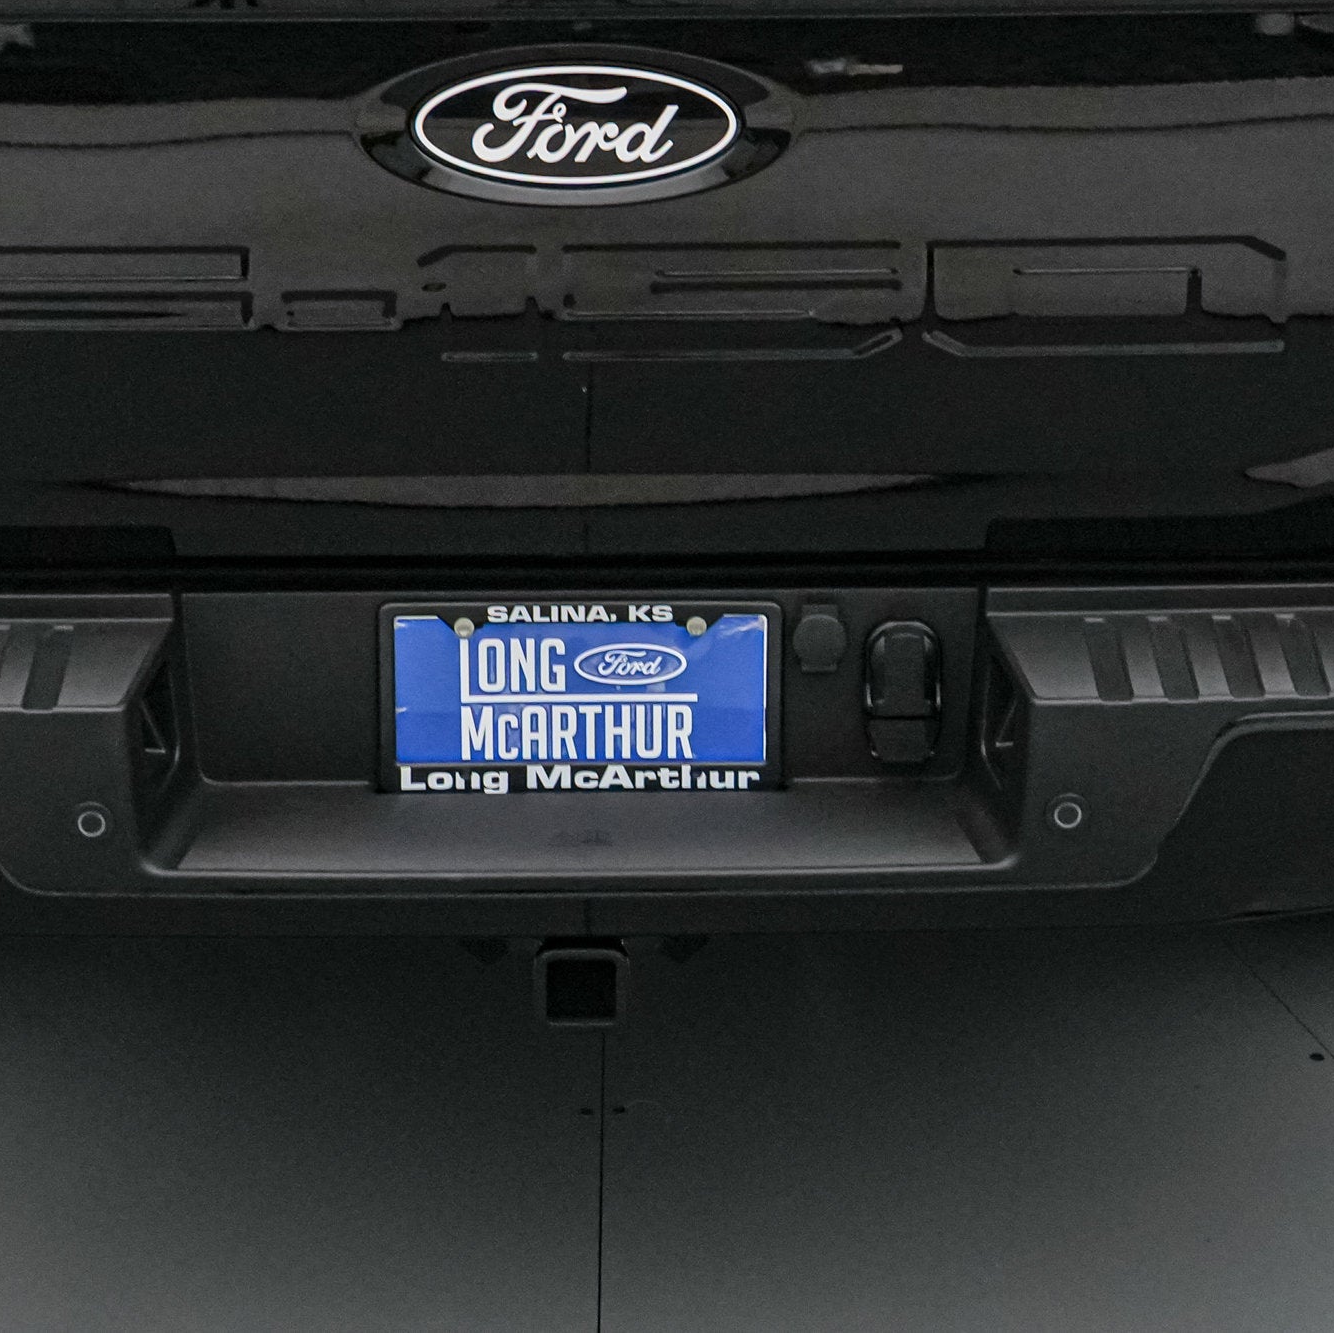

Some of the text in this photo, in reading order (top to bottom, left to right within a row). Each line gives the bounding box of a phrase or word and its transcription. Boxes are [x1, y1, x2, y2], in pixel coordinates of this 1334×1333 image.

[471, 82, 680, 164] Ford
[486, 604, 674, 624] SALINA, KS
[459, 637, 663, 702] LONG Ford
[460, 704, 695, 761] McARTHUR
[400, 764, 761, 795] Long McArthur
